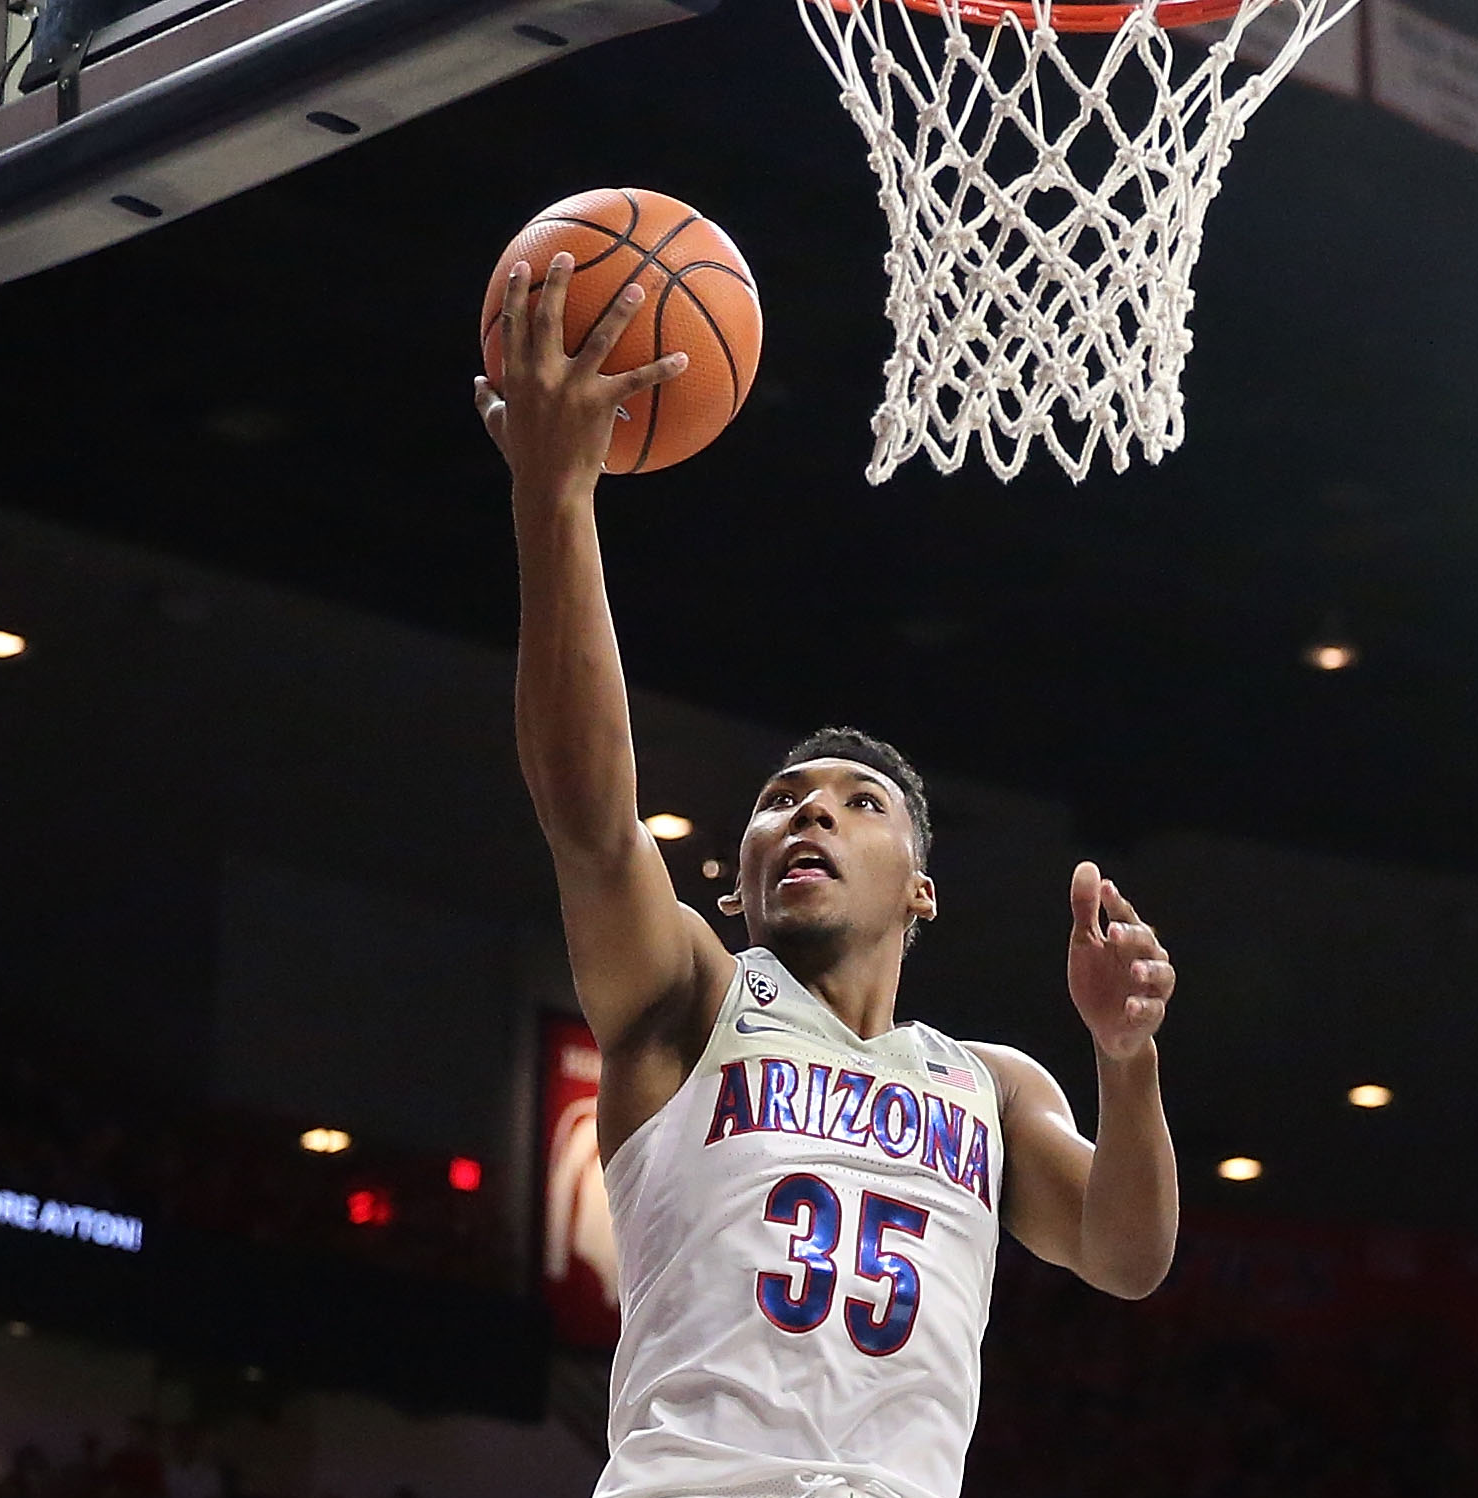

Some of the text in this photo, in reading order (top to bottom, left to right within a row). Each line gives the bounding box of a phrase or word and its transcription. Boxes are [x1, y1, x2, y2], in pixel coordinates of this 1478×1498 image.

[754, 984, 772, 1001] 12
[705, 1057, 993, 1213] ARIZONA
[756, 1172, 929, 1357] 35
